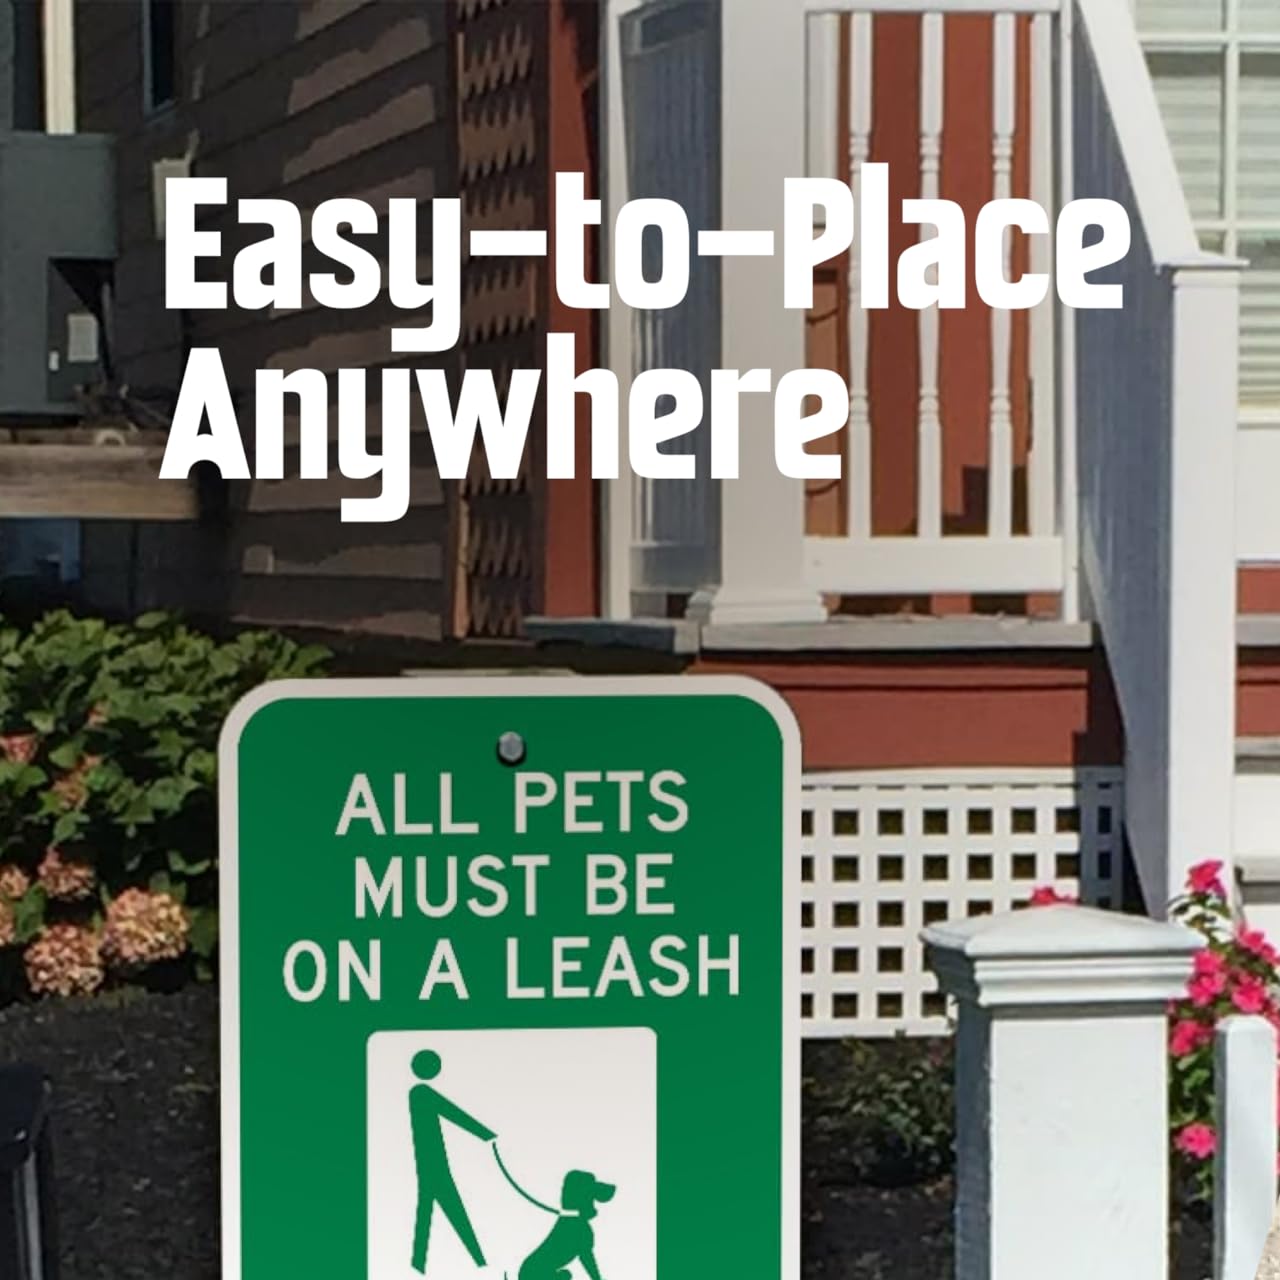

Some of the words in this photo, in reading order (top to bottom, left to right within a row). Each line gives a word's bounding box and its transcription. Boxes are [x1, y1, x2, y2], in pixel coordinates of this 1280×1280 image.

[335, 772, 479, 835] ALL
[515, 770, 688, 833] PETS
[355, 854, 550, 918] MUST
[586, 853, 675, 915] BE
[283, 939, 381, 1002] ON
[419, 939, 469, 1000] A
[507, 934, 739, 999] LEASH
